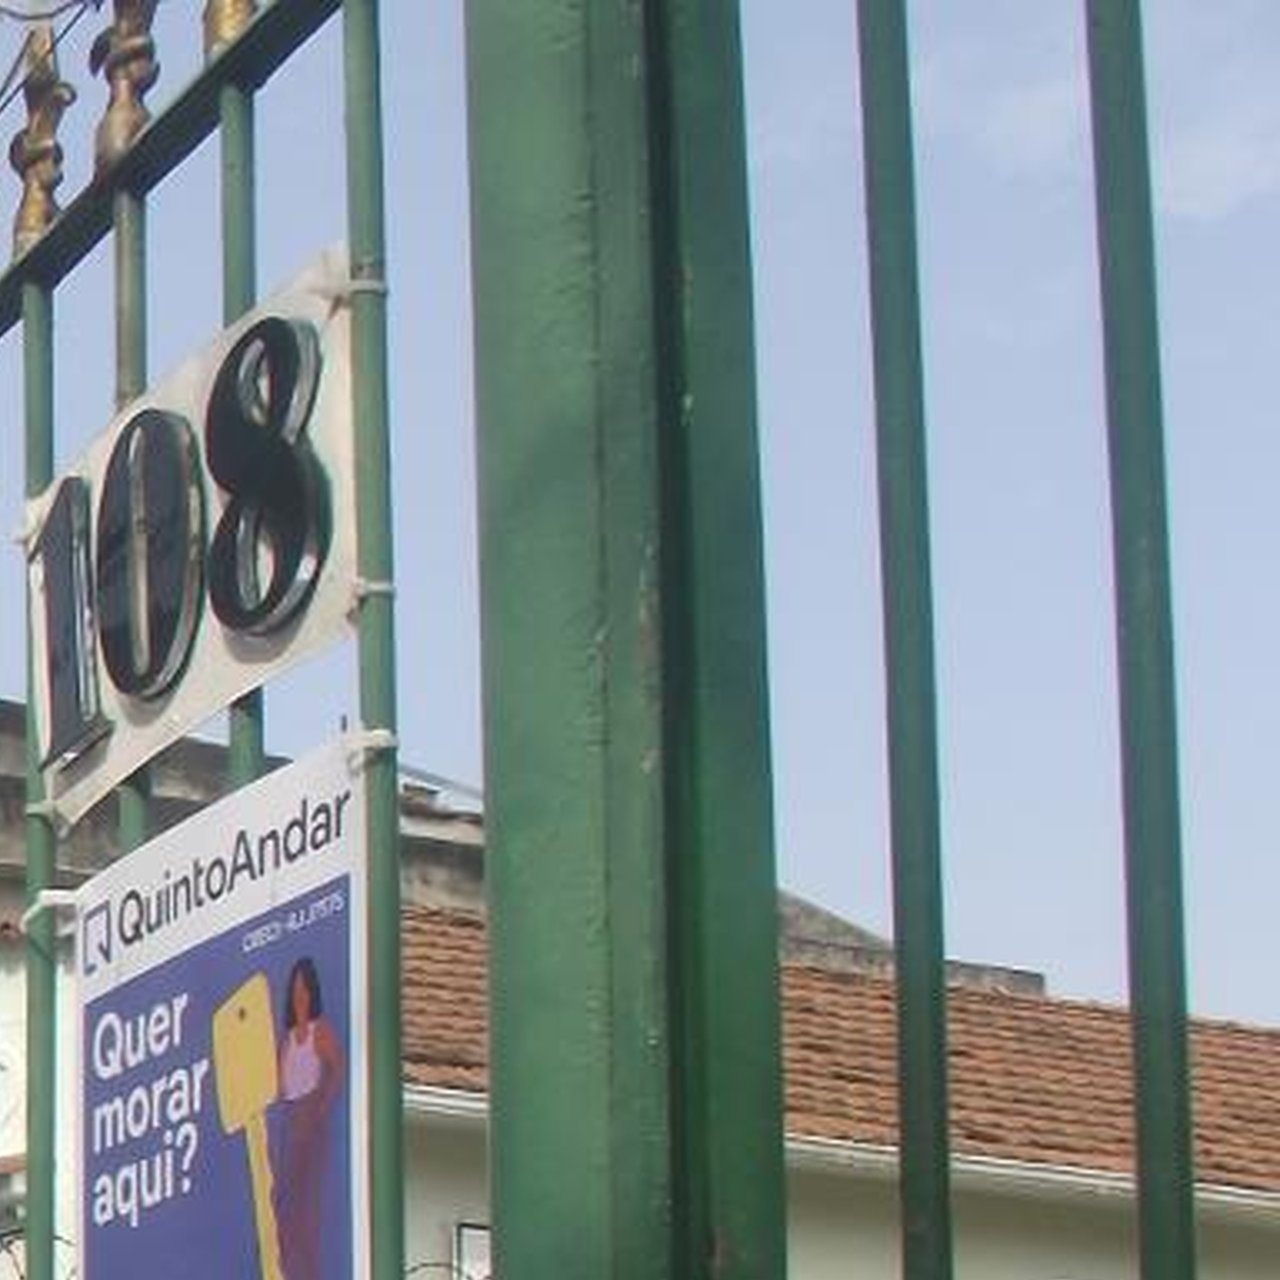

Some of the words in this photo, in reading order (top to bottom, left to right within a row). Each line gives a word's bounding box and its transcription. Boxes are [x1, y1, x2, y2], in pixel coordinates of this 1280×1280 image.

[39, 316, 331, 774] 108
[118, 790, 351, 946] QuintoAndar
[92, 992, 188, 1082] Quer
[92, 1056, 209, 1155] morar
[93, 1124, 198, 1228] aqui?
